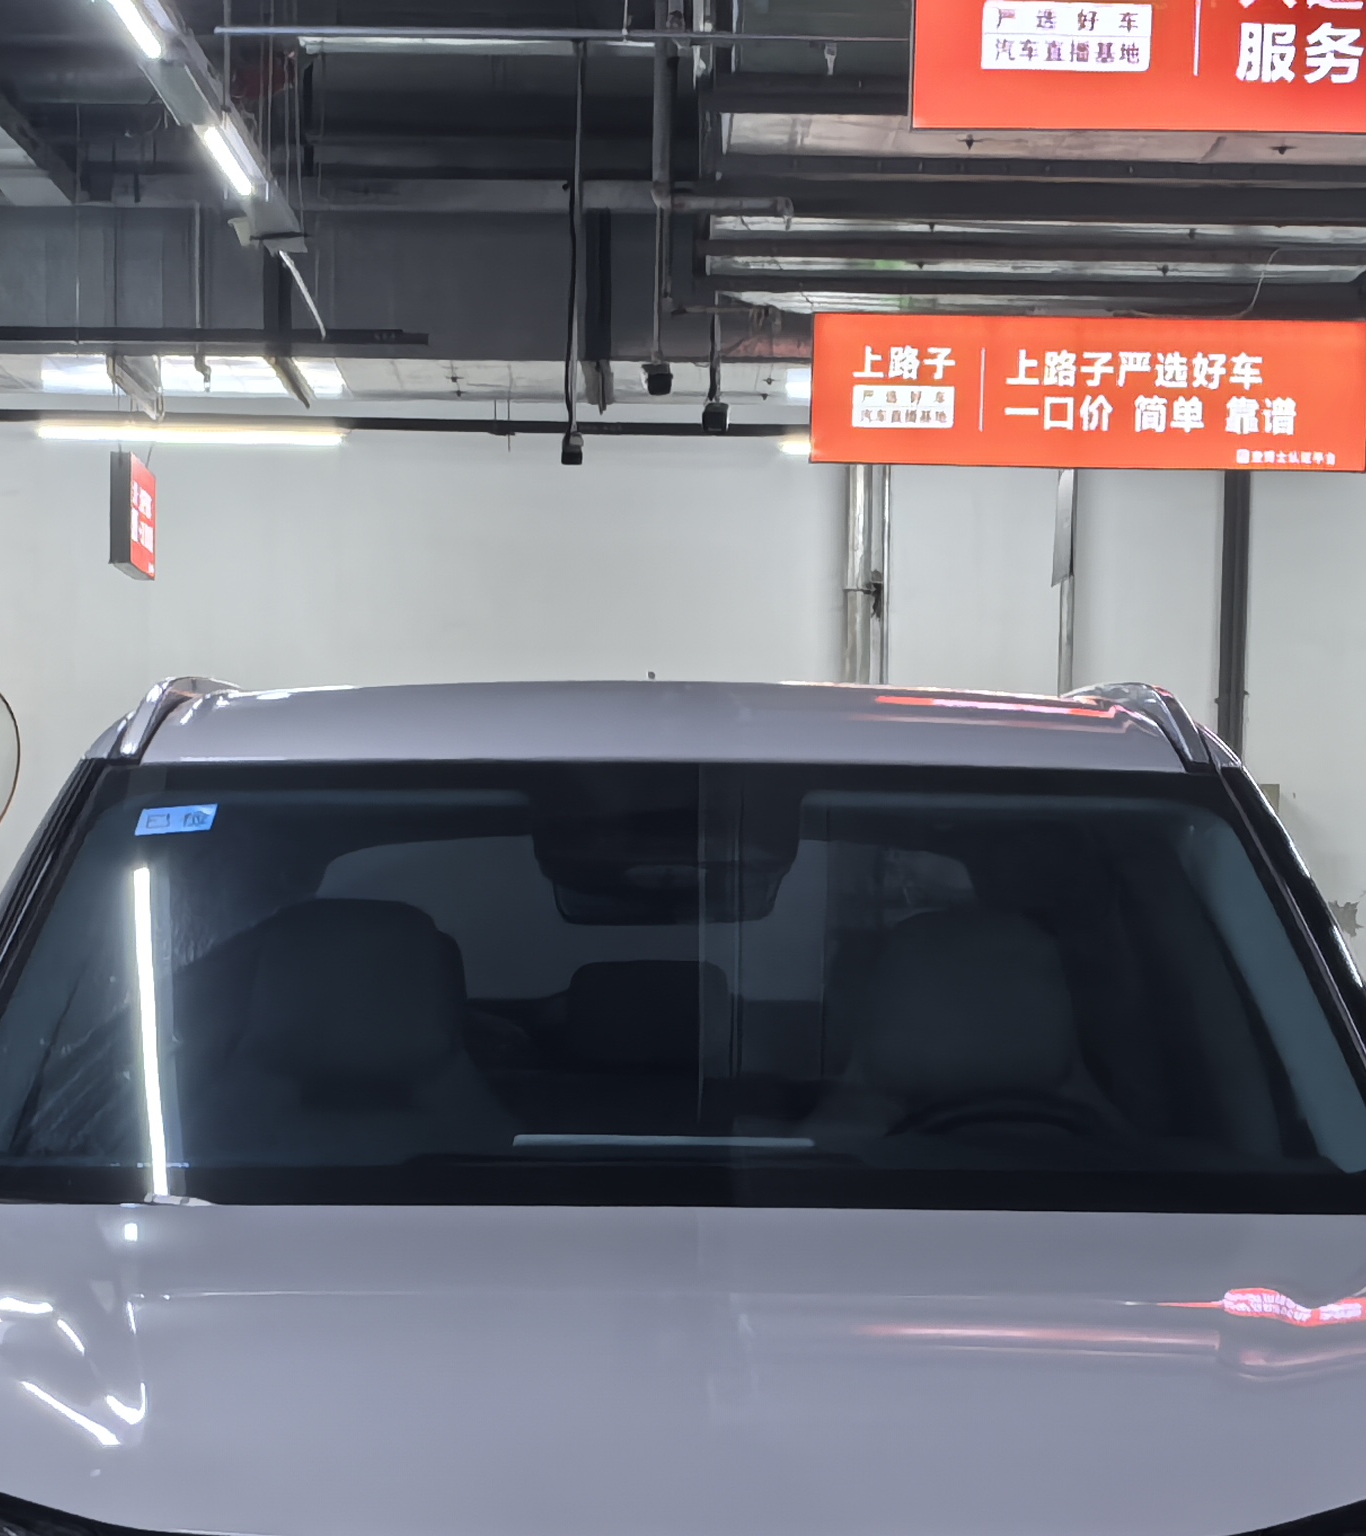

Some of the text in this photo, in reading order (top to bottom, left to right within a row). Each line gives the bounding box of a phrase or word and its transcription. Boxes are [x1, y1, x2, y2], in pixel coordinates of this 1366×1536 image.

[995, 38, 1140, 64] 汽车直播基地
[852, 345, 956, 380] 上路子
[1005, 349, 1263, 390] 上路子严选好车
[1004, 394, 1297, 436] 一口价 简单 靠谱
